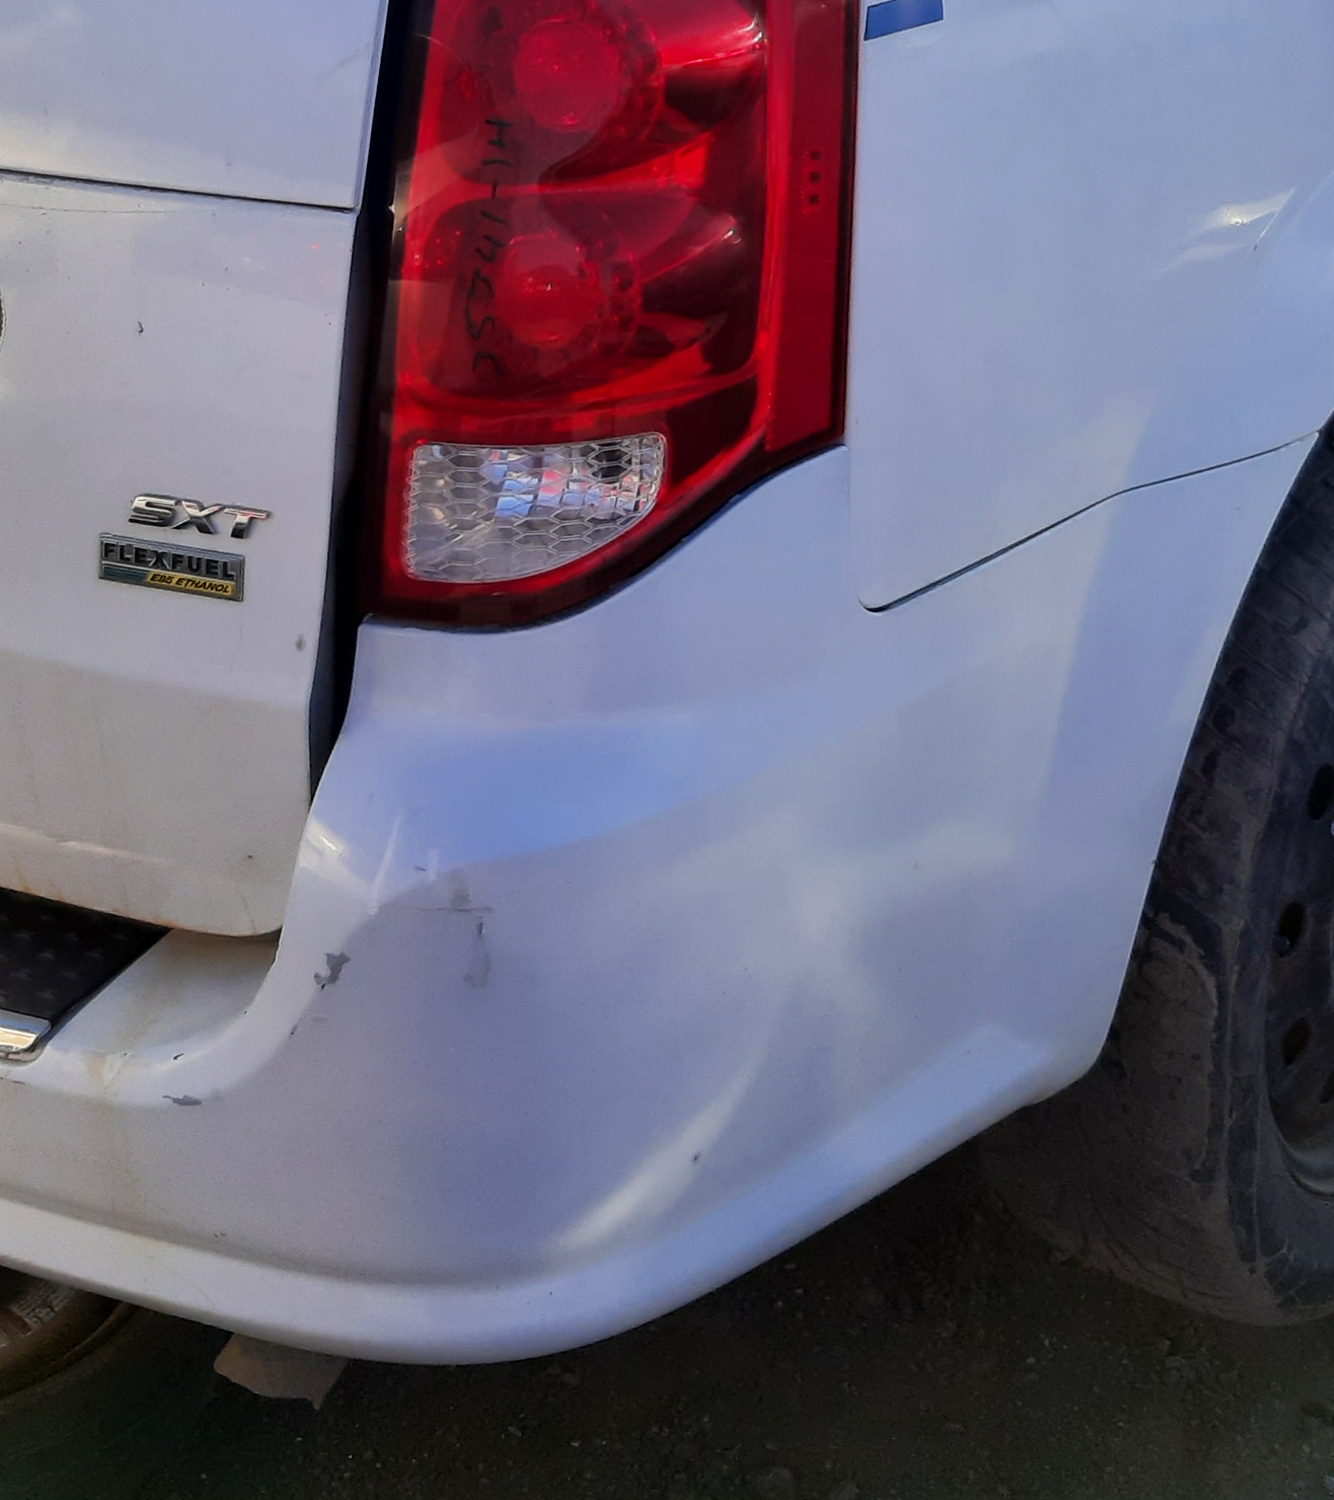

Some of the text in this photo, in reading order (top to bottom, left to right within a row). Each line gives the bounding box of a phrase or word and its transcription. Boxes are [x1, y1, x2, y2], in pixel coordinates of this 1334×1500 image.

[128, 493, 273, 540] SXT
[102, 542, 236, 581] FLEXFUEL
[175, 577, 230, 594] ETHANOL
